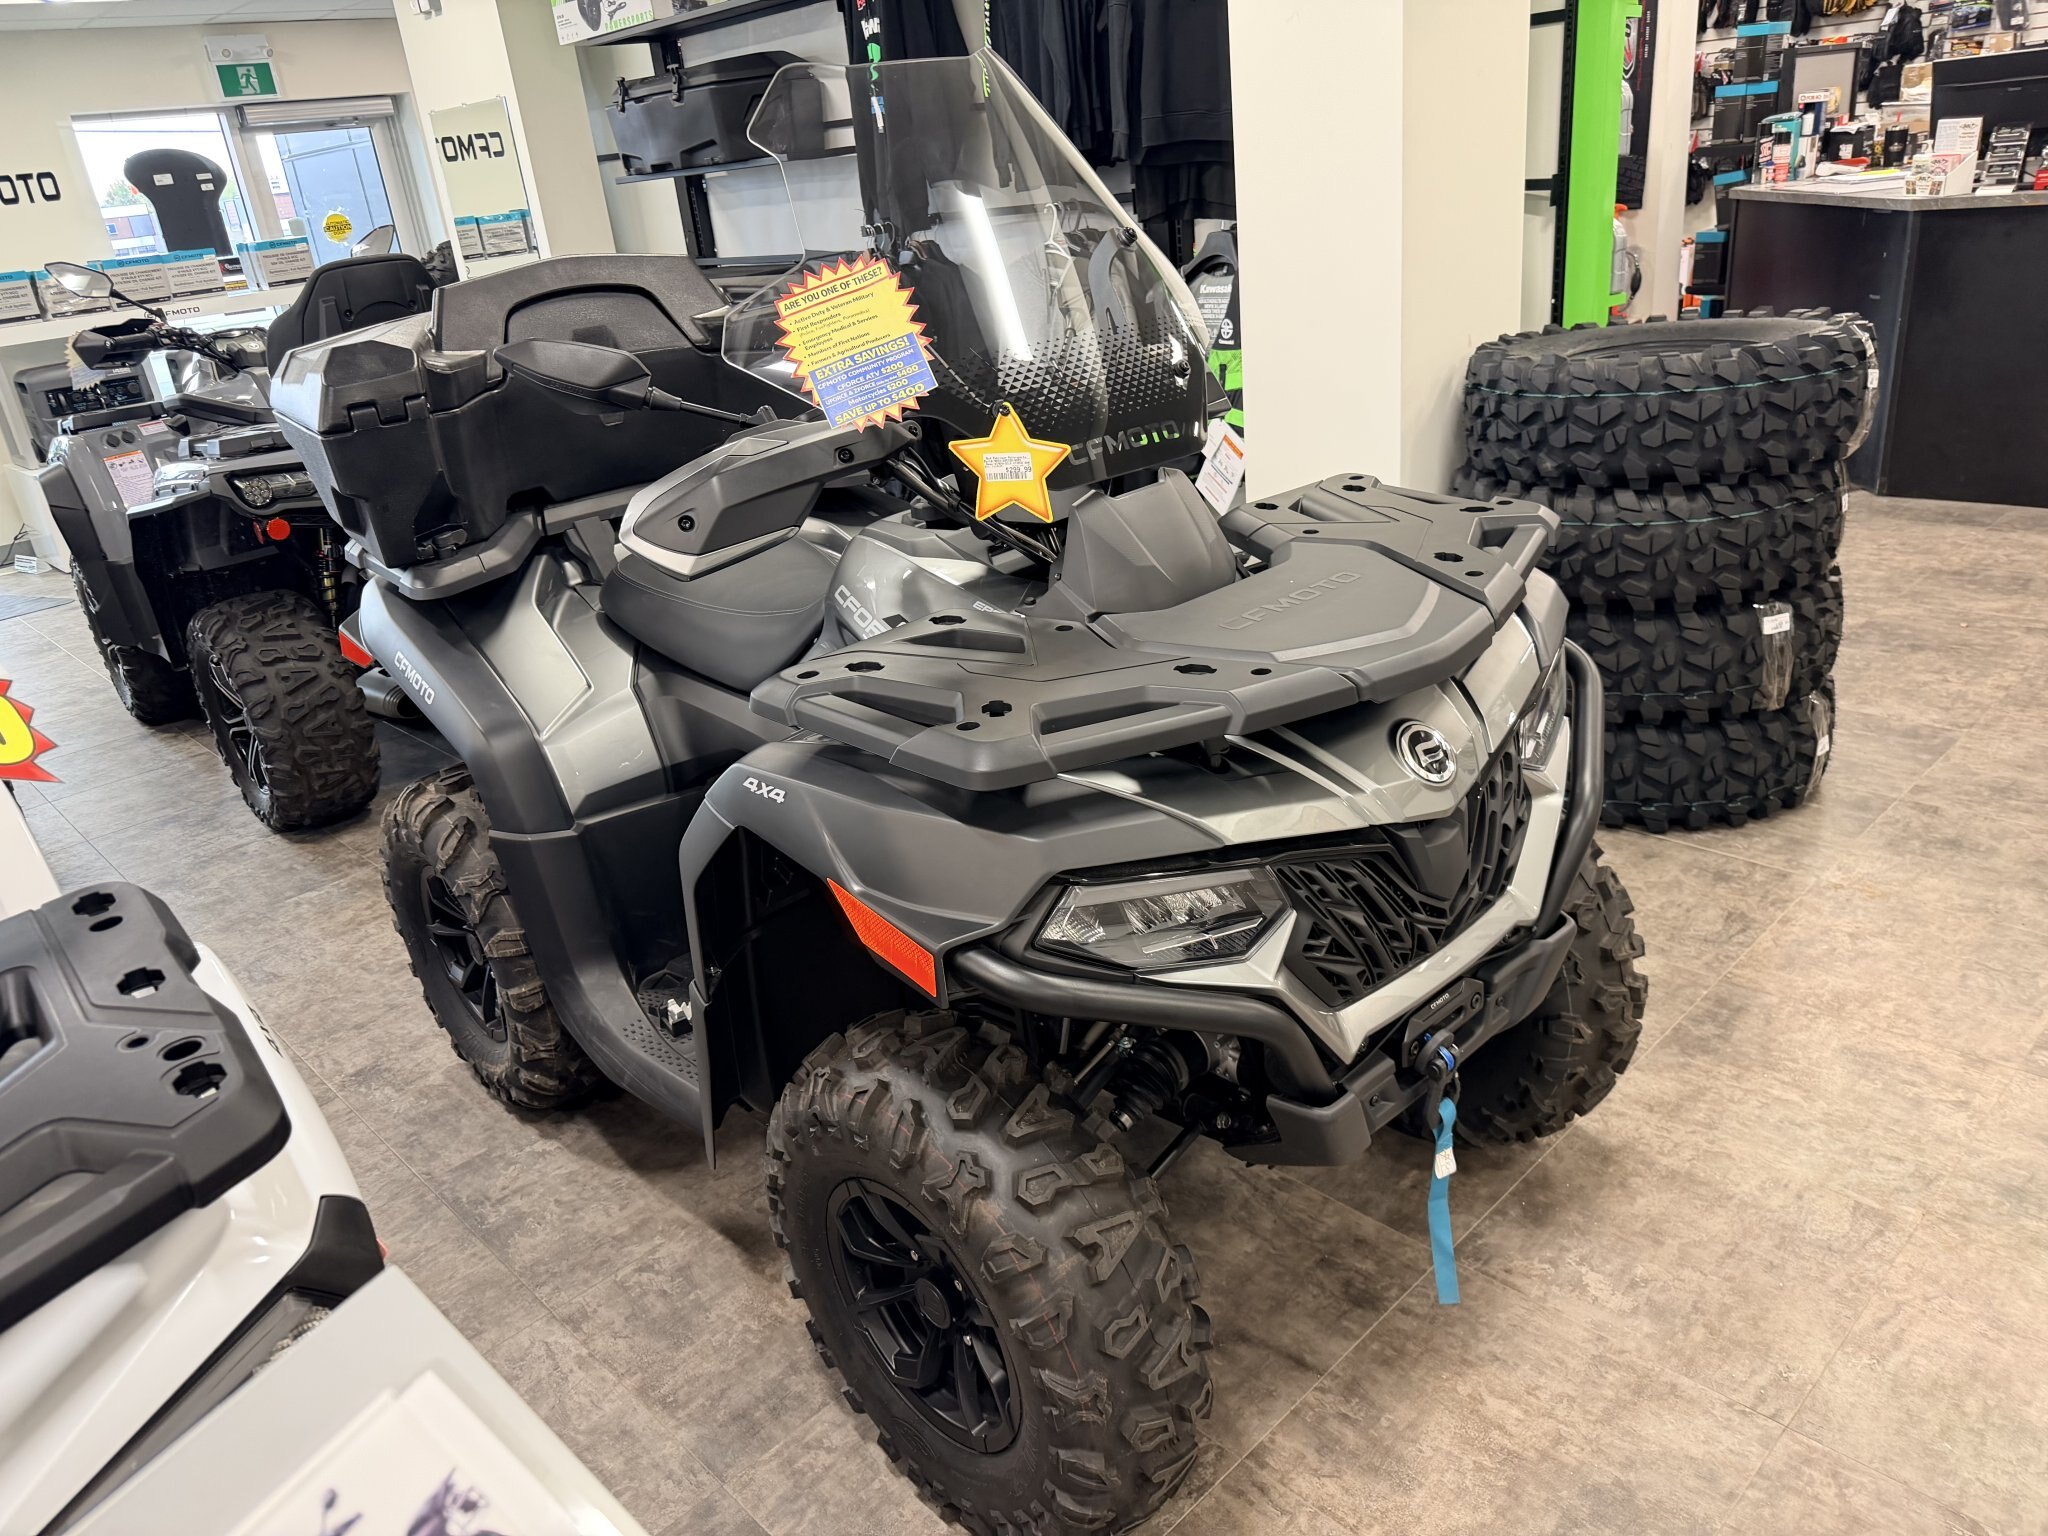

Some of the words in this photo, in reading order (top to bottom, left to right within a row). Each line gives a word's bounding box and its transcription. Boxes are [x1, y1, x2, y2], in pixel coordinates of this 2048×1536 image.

[605, 10, 653, 32] POWERSPORTS
[325, 224, 351, 232] CAUTION
[783, 300, 802, 313] ARE
[801, 291, 821, 306] YOU
[821, 284, 839, 298] ONE
[840, 279, 852, 291] OF
[853, 266, 883, 287] THESE?
[793, 312, 812, 326] Active
[811, 308, 826, 322] Duty
[831, 299, 853, 312] Veteran
[852, 291, 875, 305] Military
[796, 322, 810, 333] First
[809, 311, 842, 328] Responders
[802, 331, 832, 346] Emergency
[831, 322, 852, 335] Medical
[857, 313, 879, 325] Services
[804, 335, 834, 351] Employees
[807, 345, 832, 359] Members
[838, 337, 851, 348] First
[850, 331, 871, 344] Nations
[811, 354, 831, 367] Farmers
[836, 342, 866, 358] Agricultural
[864, 333, 891, 347] Producers
[816, 358, 854, 380] EXTRA
[854, 336, 911, 365] SAVINGS!
[817, 374, 848, 391] CFMOTO
[847, 360, 886, 379] COMMUNITY
[885, 348, 915, 364] PROGRAM
[825, 392, 850, 405] UFORCE
[854, 382, 877, 396] ZFORCE
[896, 365, 919, 379] $400
[837, 376, 866, 392] CFORCE
[865, 370, 881, 382] ATV
[881, 361, 904, 377] $200
[835, 406, 864, 425] SAVE
[865, 401, 878, 413] UP
[878, 396, 891, 409] TO
[891, 383, 926, 402] $400
[847, 386, 888, 406] Motorcycles
[886, 378, 909, 392] $200
[1069, 420, 1181, 466] CFMOTO
[834, 585, 891, 640] CFOR
[1217, 570, 1362, 630] CFMOTO
[394, 650, 435, 705] CFMOTO
[1430, 992, 1450, 1010] CFMOTO
